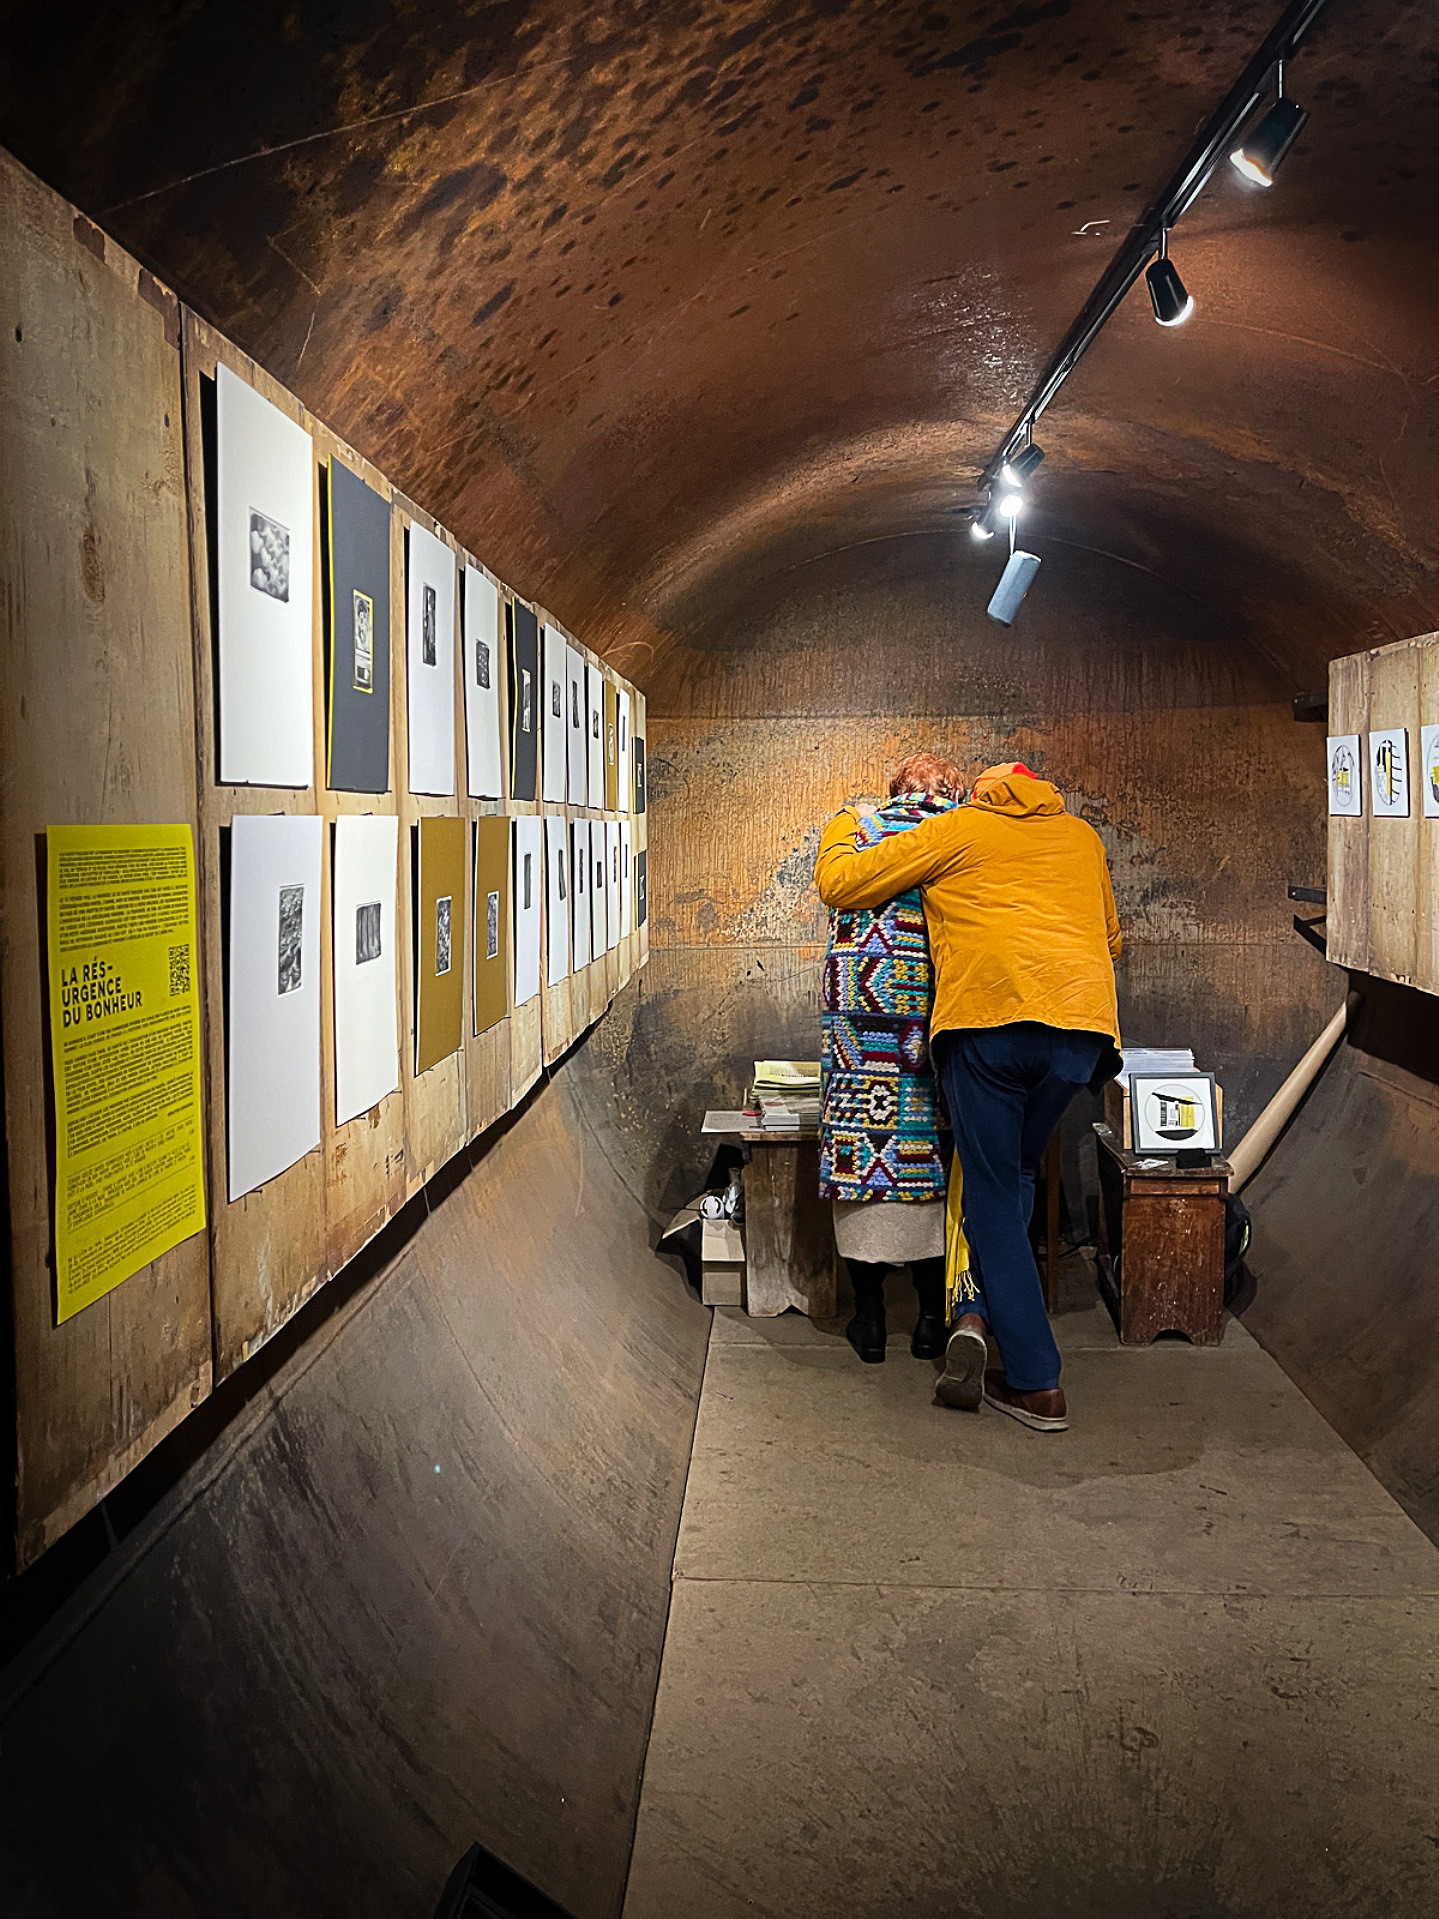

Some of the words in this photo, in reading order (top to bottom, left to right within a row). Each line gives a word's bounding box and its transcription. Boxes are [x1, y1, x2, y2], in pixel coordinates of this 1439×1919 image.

[62, 967, 78, 987] LA
[83, 955, 113, 982] RÉS-
[62, 977, 121, 1007] URGENCE
[63, 1006, 81, 1028] DU
[87, 991, 142, 1021] BONHEUR
